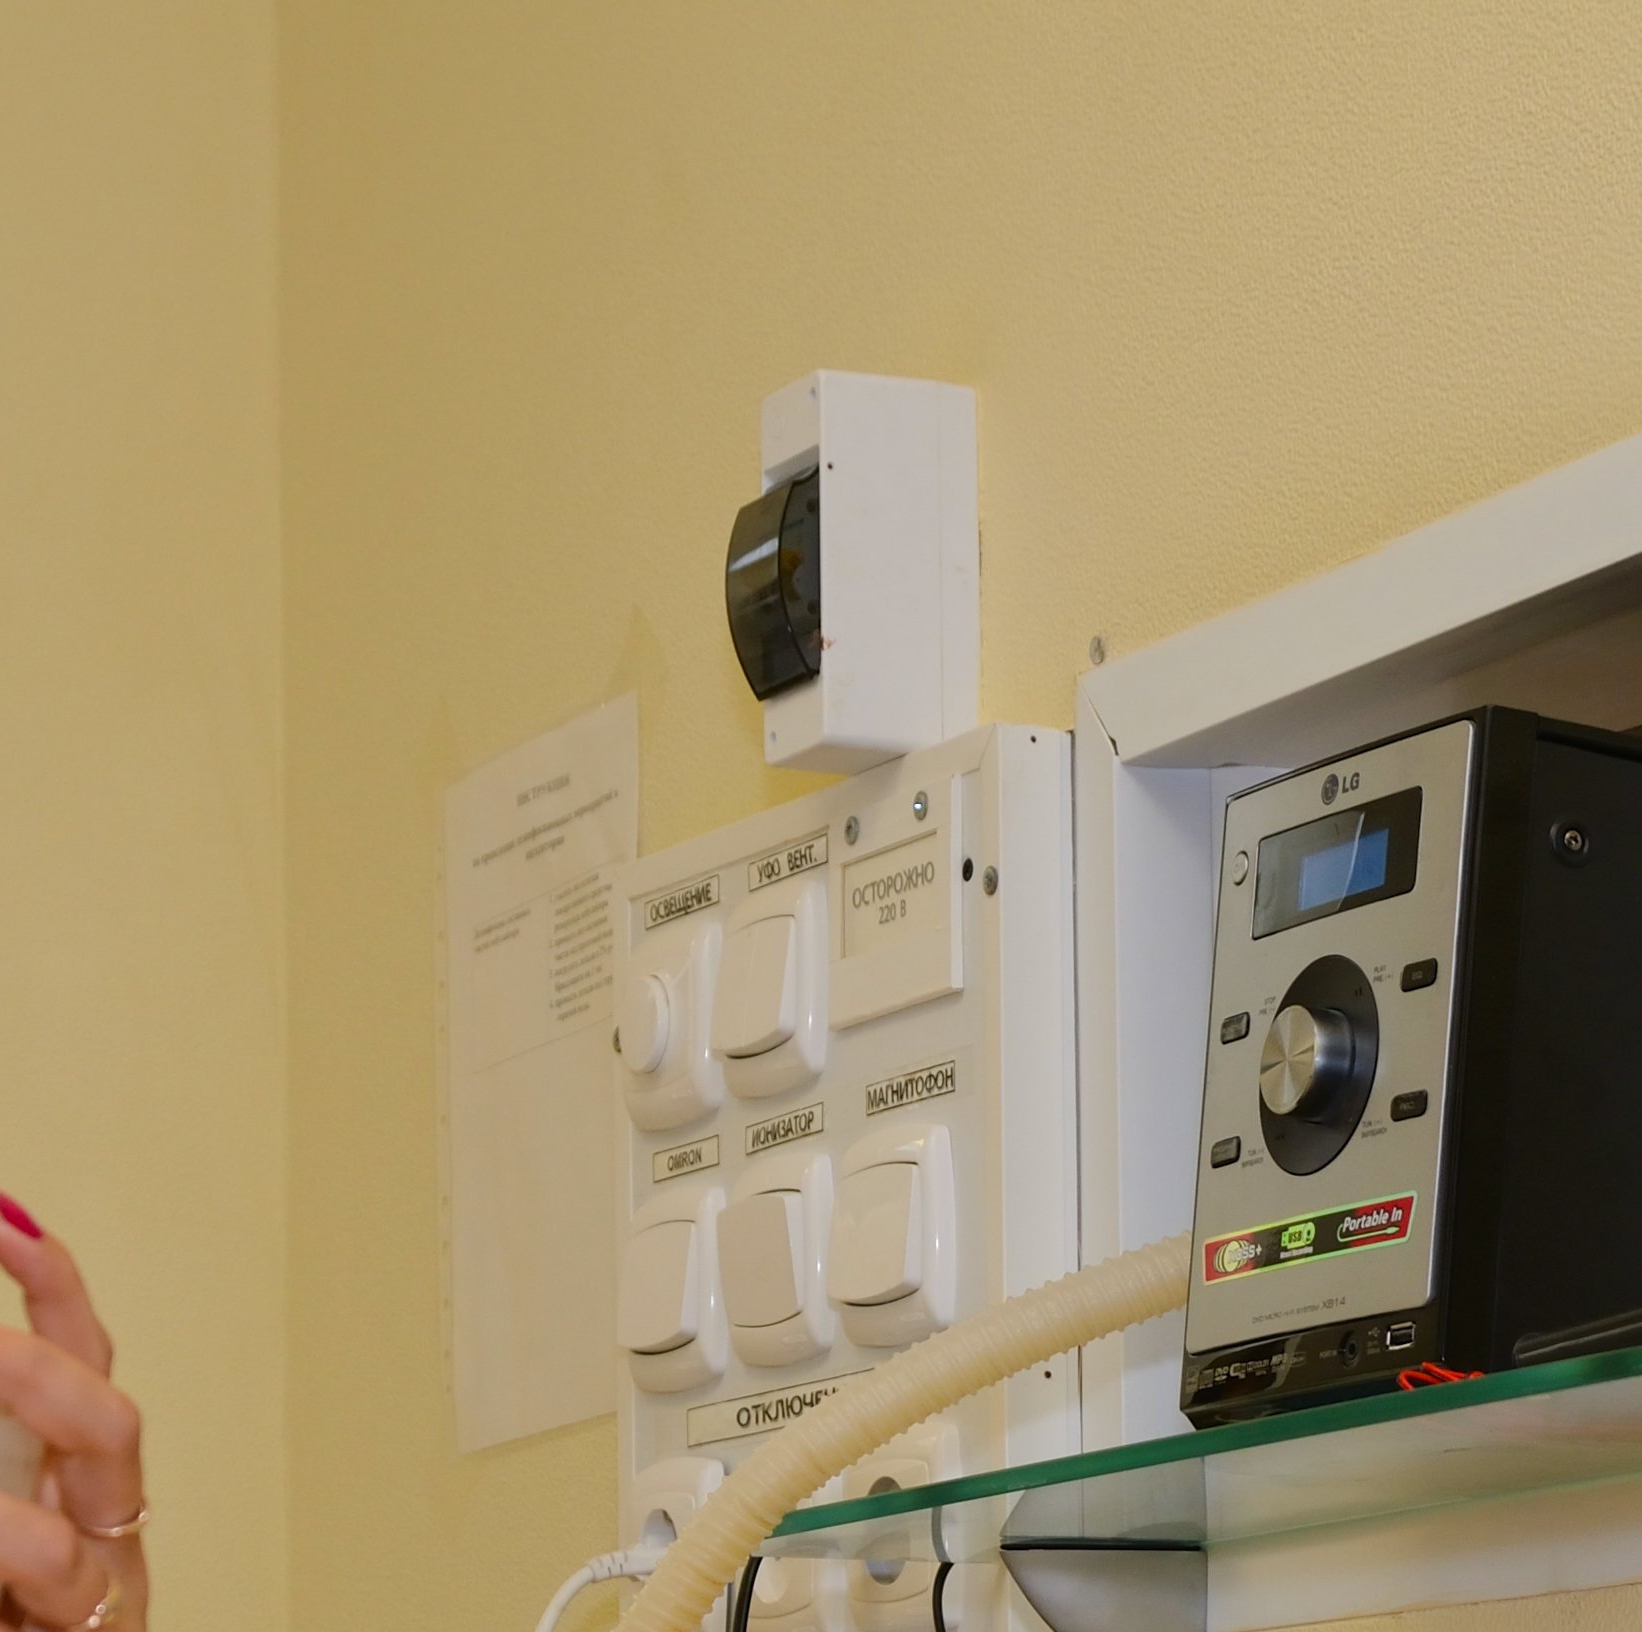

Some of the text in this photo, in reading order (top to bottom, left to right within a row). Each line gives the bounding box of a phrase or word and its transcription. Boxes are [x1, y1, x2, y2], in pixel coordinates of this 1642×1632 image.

[1342, 772, 1360, 793] LG
[758, 844, 818, 882] УФО ВЕНТ.
[650, 882, 713, 922] ОСВЕЩЕНИЕ
[852, 861, 935, 908] ОСТОРОЖНО
[878, 899, 907, 924] 220 В
[866, 1066, 955, 1111] МАГНИТОФОН
[751, 1110, 815, 1148] ИОНИЗАТОР
[667, 1147, 703, 1172] OMRON
[1342, 1206, 1403, 1233] Portable In
